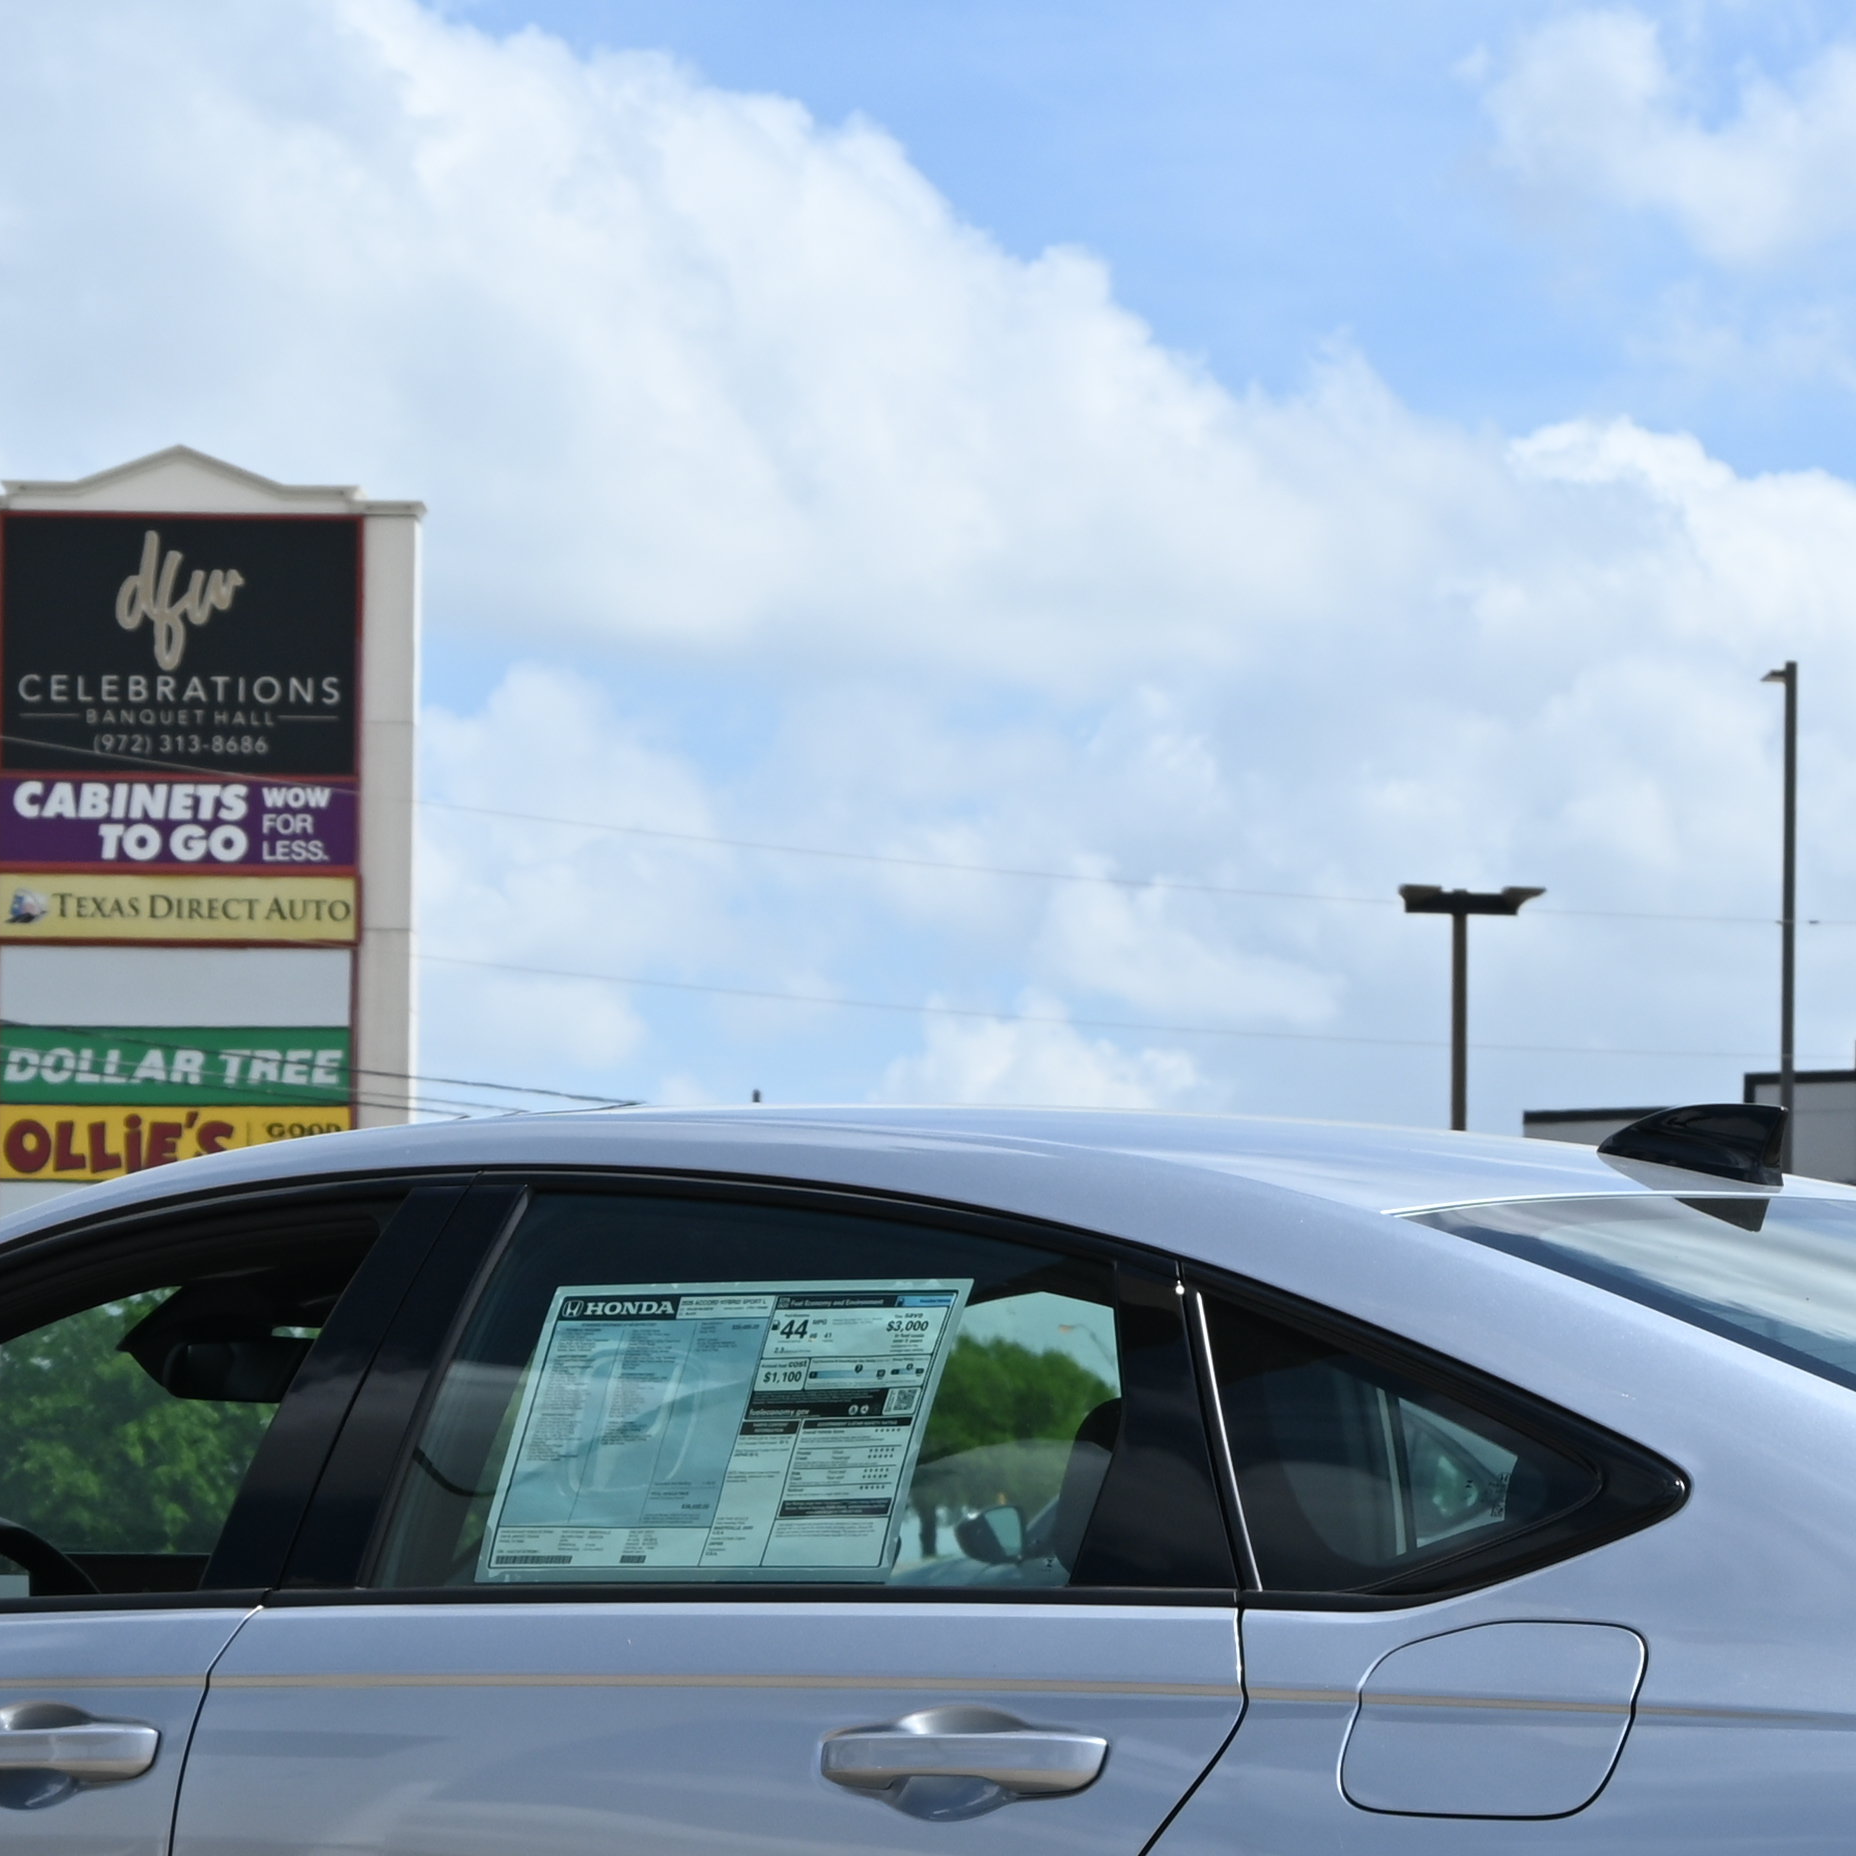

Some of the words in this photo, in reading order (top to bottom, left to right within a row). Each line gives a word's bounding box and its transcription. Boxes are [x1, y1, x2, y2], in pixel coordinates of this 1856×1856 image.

[115, 529, 245, 672] dfw
[18, 673, 341, 704] CELEBRATIONS
[85, 709, 205, 726] BANQUET
[214, 711, 275, 727] HALL
[93, 733, 152, 756] (972)
[159, 734, 269, 756] 313-8686
[13, 780, 249, 822] CABINETS
[261, 787, 332, 808] WOW
[261, 813, 314, 835] FOR
[98, 823, 162, 861] TO
[169, 824, 249, 862] GO
[261, 840, 330, 862] LESS.
[52, 892, 140, 919] TEXAS
[148, 894, 261, 921] DIRECT
[265, 896, 351, 922] AUTO
[3, 1048, 208, 1085] DOLLAR
[218, 1049, 344, 1086] TREE
[583, 1300, 675, 1316] HONDA
[779, 1319, 809, 1340] 44
[885, 1320, 930, 1333] $3,000
[763, 1370, 803, 1384] $1,100
